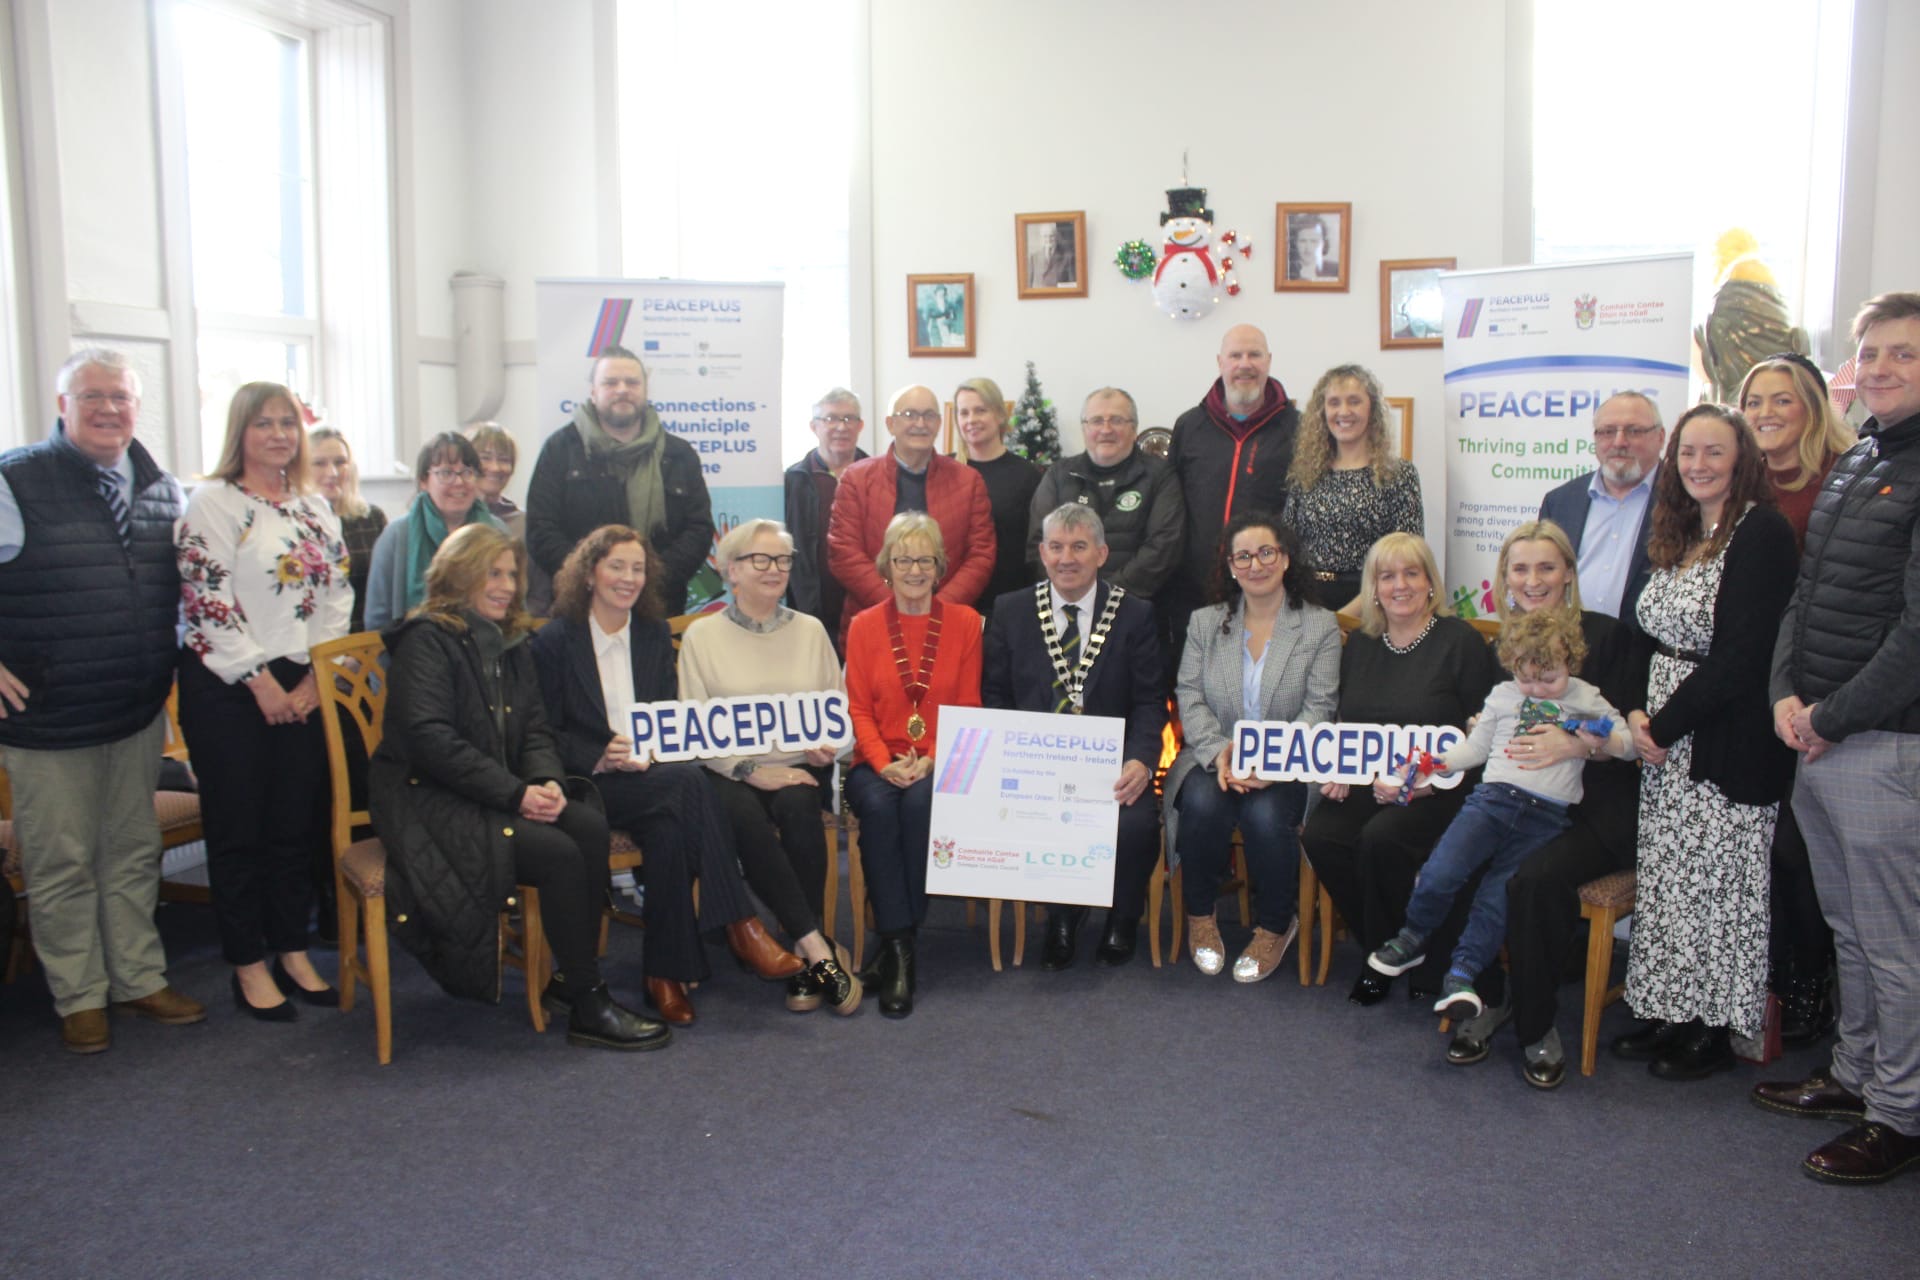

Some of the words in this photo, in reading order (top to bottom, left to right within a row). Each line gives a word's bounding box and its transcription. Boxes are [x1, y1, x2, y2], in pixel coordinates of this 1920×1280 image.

[642, 298, 741, 312] PEACEPLUS
[1489, 293, 1550, 305] PEACEPLUS
[662, 418, 750, 434] Municiple
[1458, 438, 1527, 456] Thriving
[1532, 438, 1569, 454] and
[1459, 502, 1518, 515] Programmes
[1456, 516, 1484, 527] among
[1486, 516, 1522, 527] diverse
[1476, 543, 1486, 552] to
[631, 697, 846, 755] PEACEPLUS
[1003, 730, 1118, 753] PEACEPLUS
[1003, 750, 1044, 760] Northern
[1046, 752, 1078, 762] Ireland
[1085, 755, 1117, 765] Ireland
